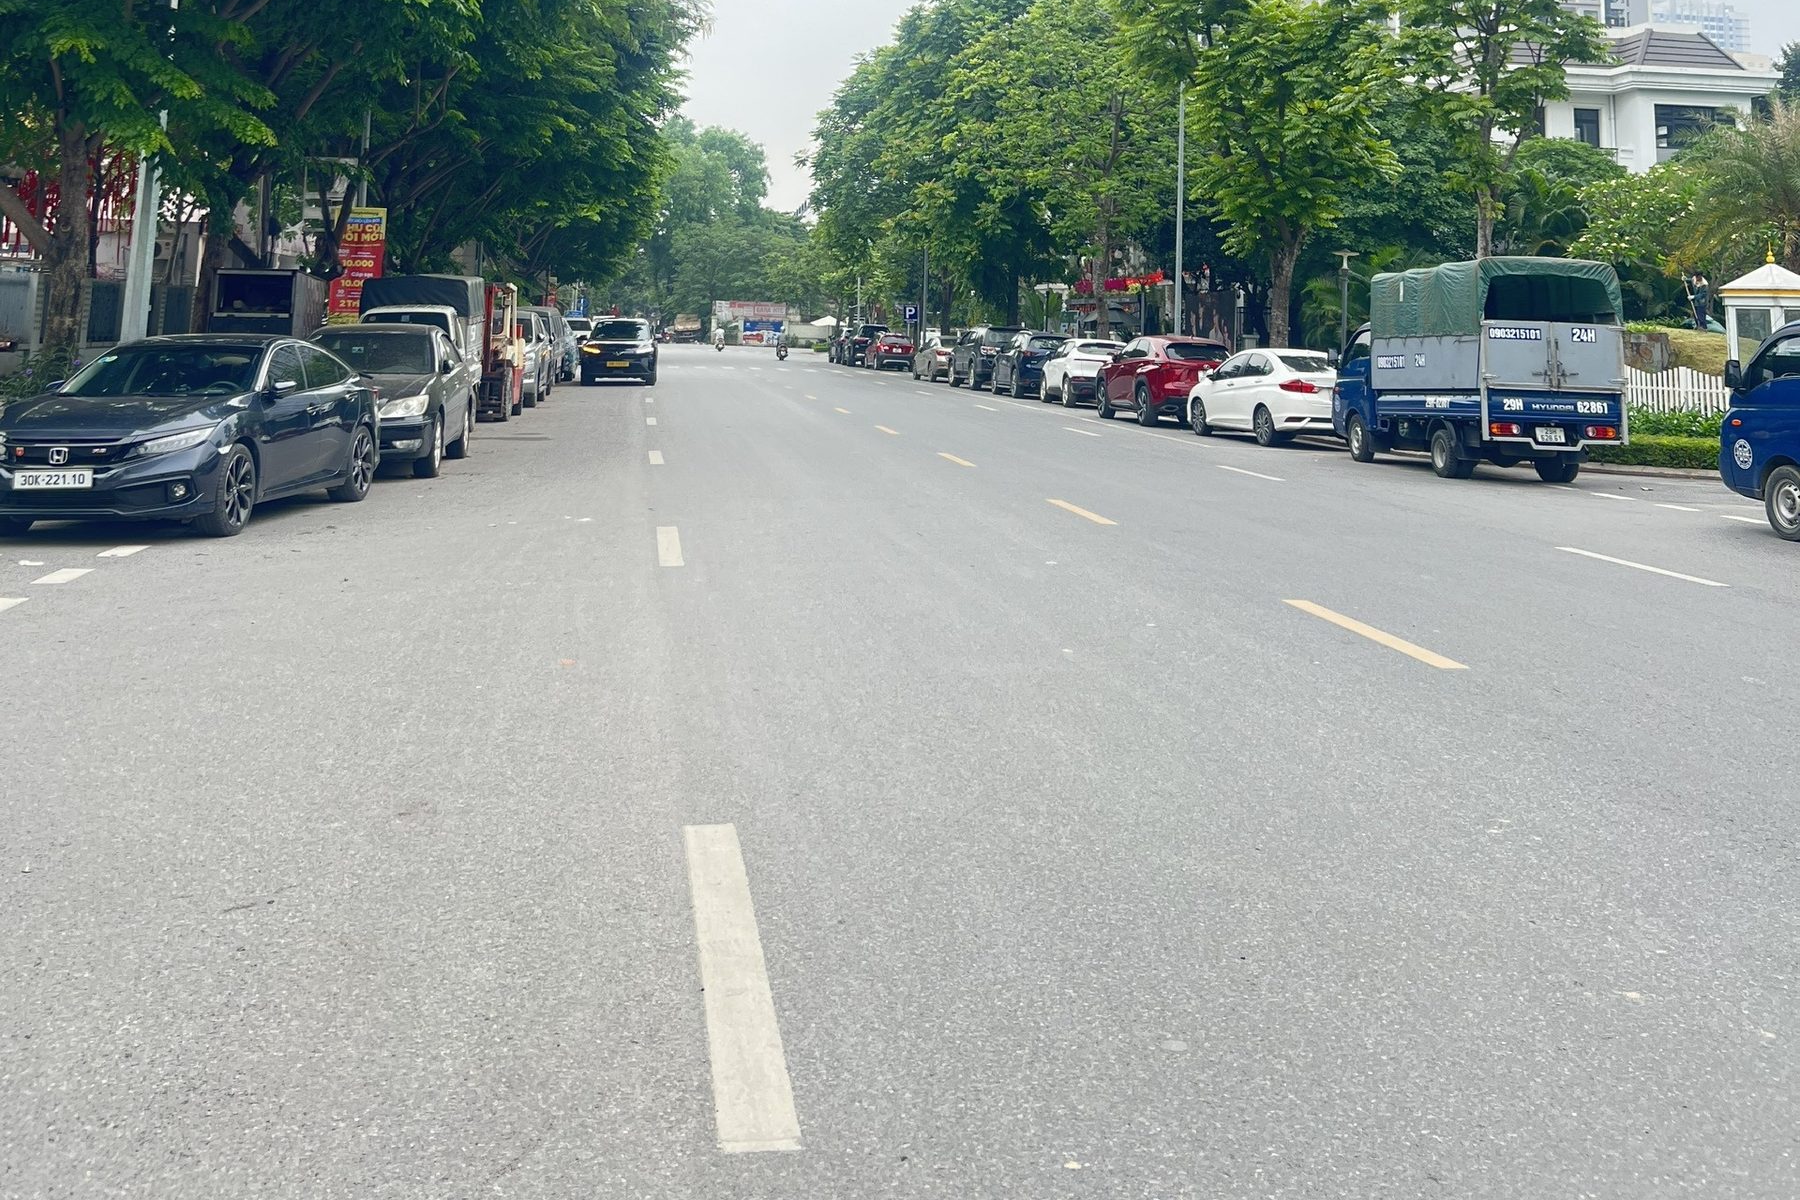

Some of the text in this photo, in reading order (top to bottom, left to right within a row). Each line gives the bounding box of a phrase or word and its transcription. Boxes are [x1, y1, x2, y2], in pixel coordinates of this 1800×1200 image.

[346, 223, 363, 232] HU
[342, 259, 374, 267] 10.000
[906, 307, 915, 319] P
[1490, 328, 1540, 339] 0903215101
[1572, 328, 1596, 342] 24H
[1503, 399, 1524, 410] 29H
[1577, 401, 1608, 413] 62861
[20, 474, 85, 486] 30K-221.10
